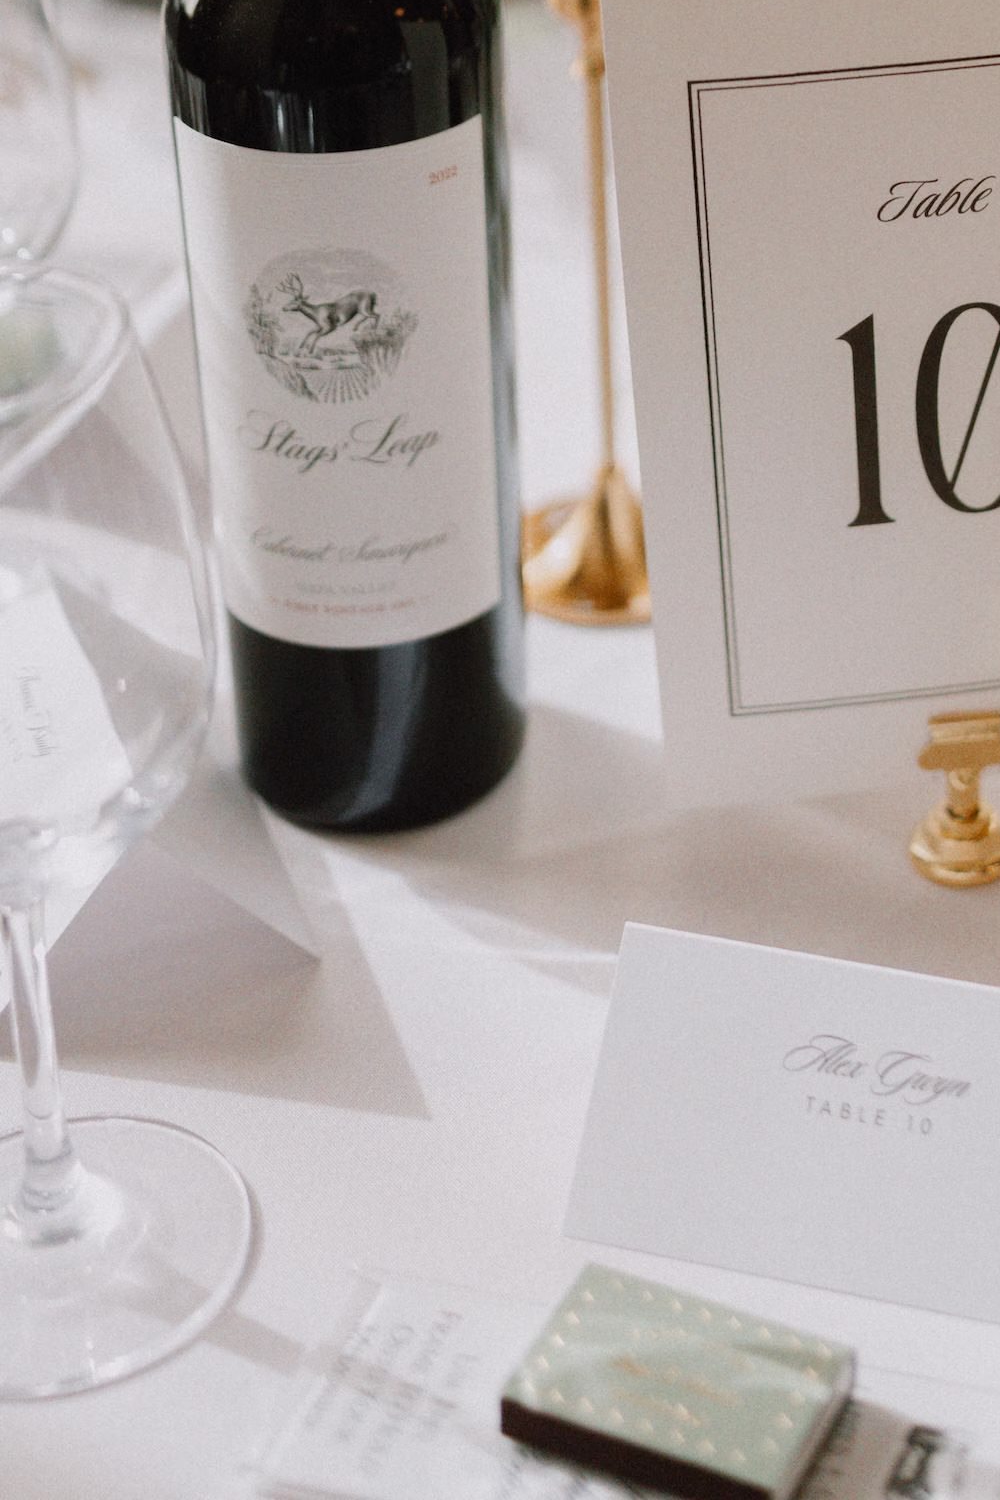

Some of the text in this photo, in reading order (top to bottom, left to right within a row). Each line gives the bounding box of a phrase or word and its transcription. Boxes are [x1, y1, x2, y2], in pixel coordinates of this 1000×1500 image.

[877, 175, 996, 223] Table
[351, 413, 440, 467] Leap
[783, 1034, 867, 1079] Alex
[806, 1095, 934, 1136] TABLE 10
